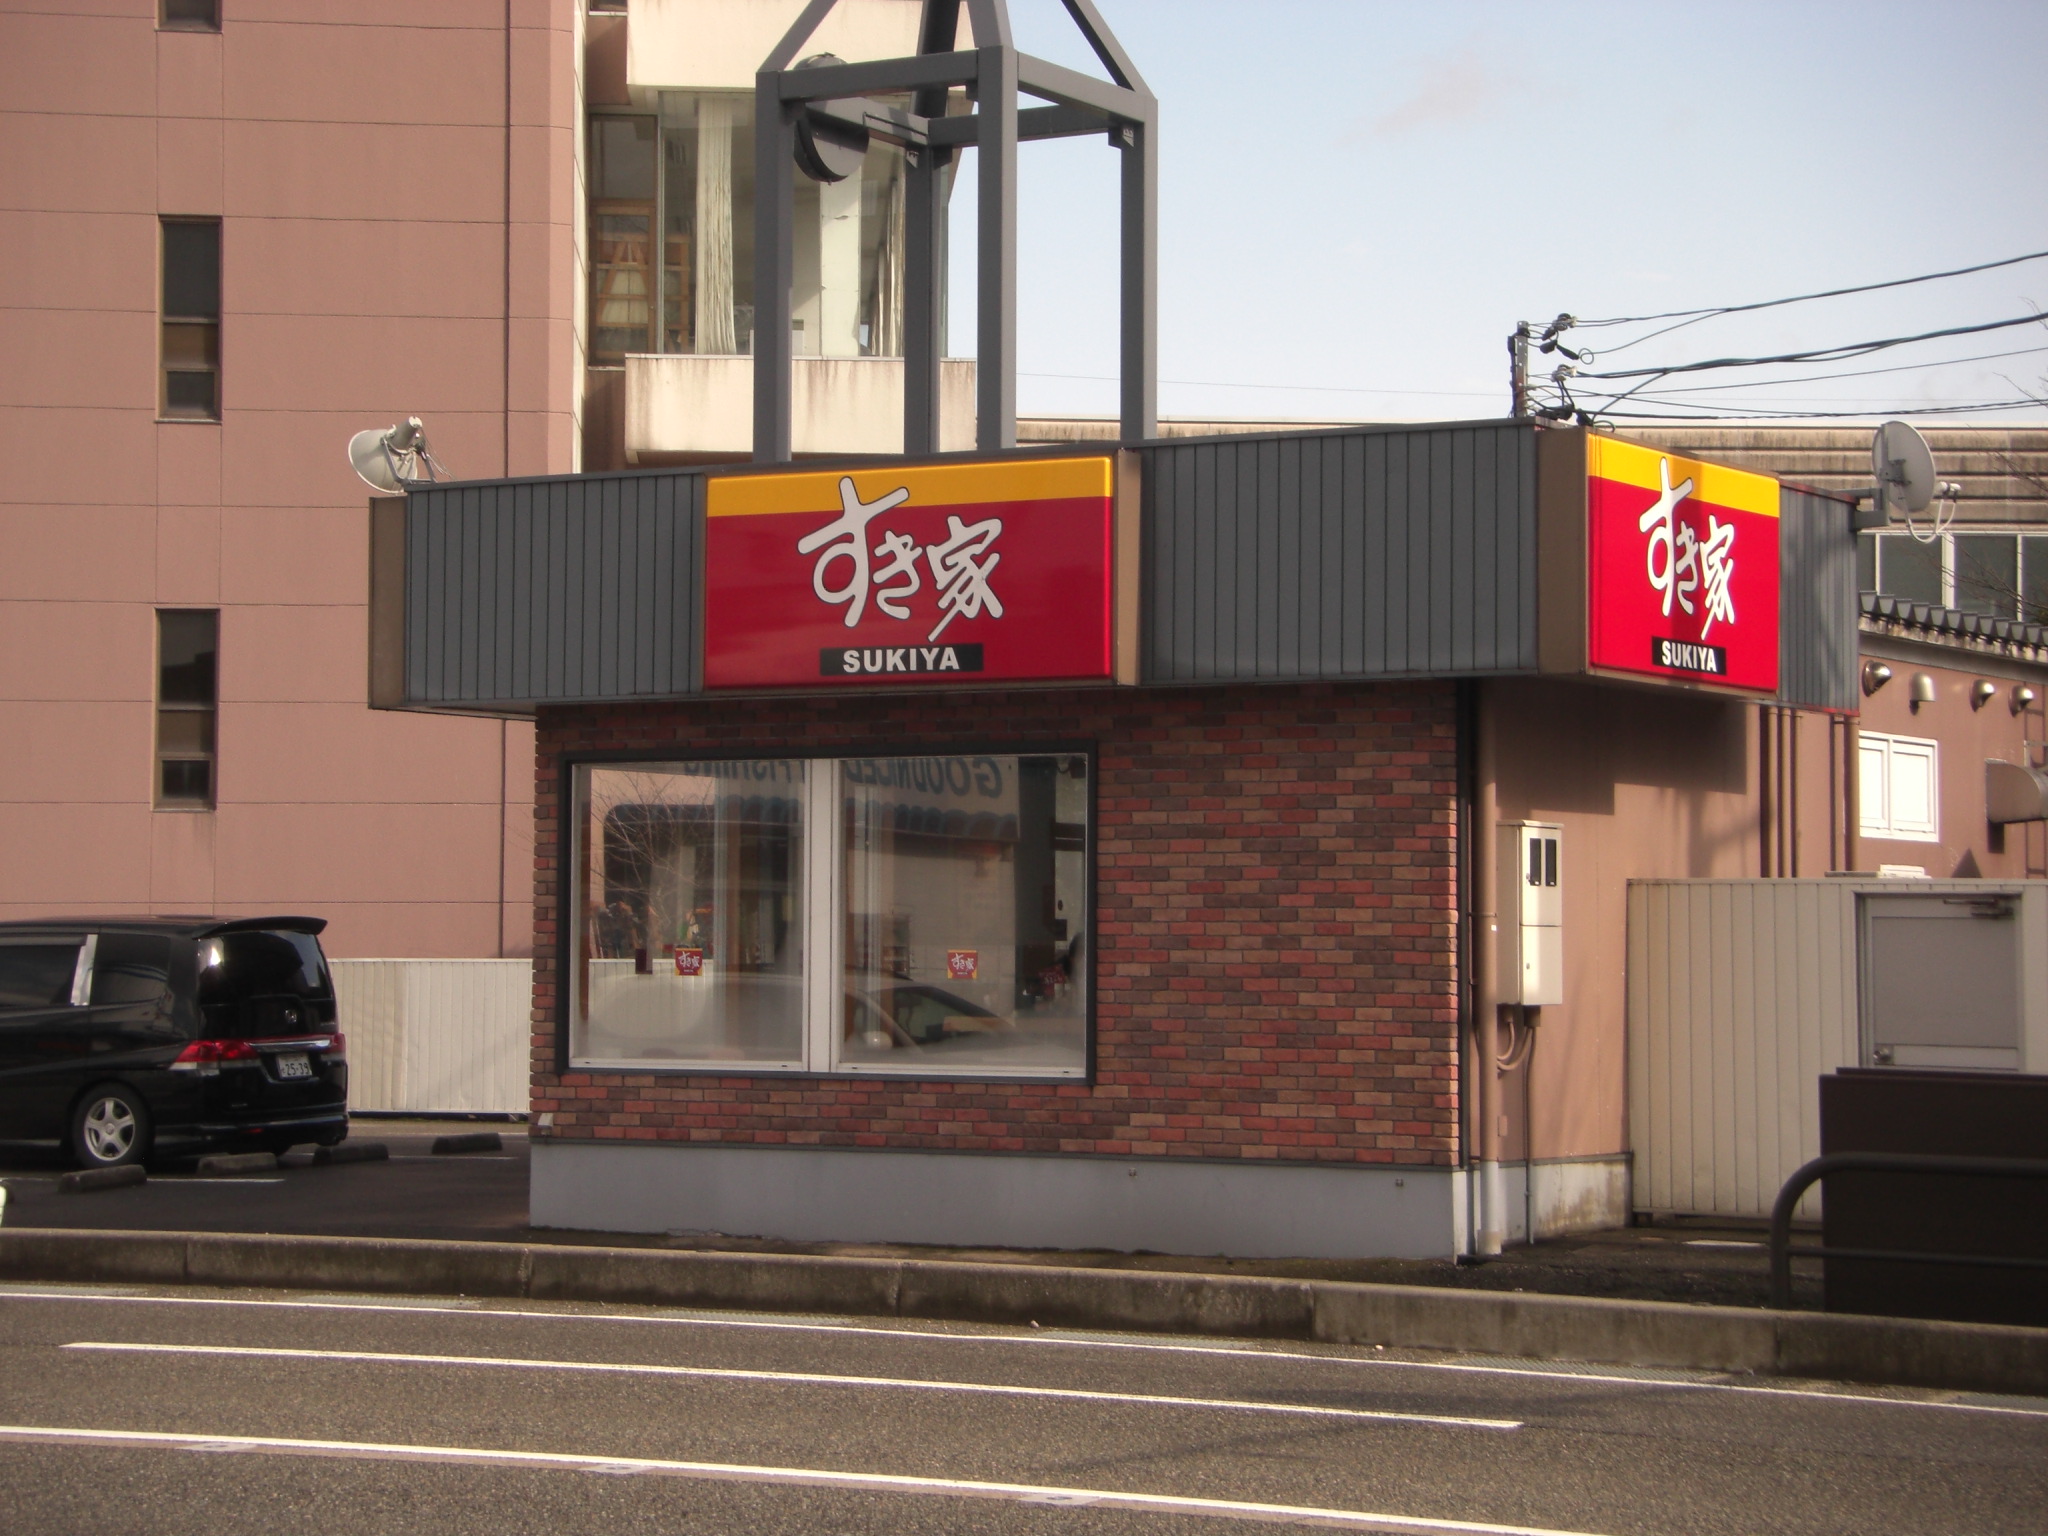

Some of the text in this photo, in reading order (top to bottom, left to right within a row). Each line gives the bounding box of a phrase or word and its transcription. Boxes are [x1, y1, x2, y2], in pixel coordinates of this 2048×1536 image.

[797, 476, 1003, 641] すき家
[1638, 456, 1735, 640] すき家
[843, 647, 960, 673] SUKIYA
[1661, 640, 1718, 672] SUKIYA
